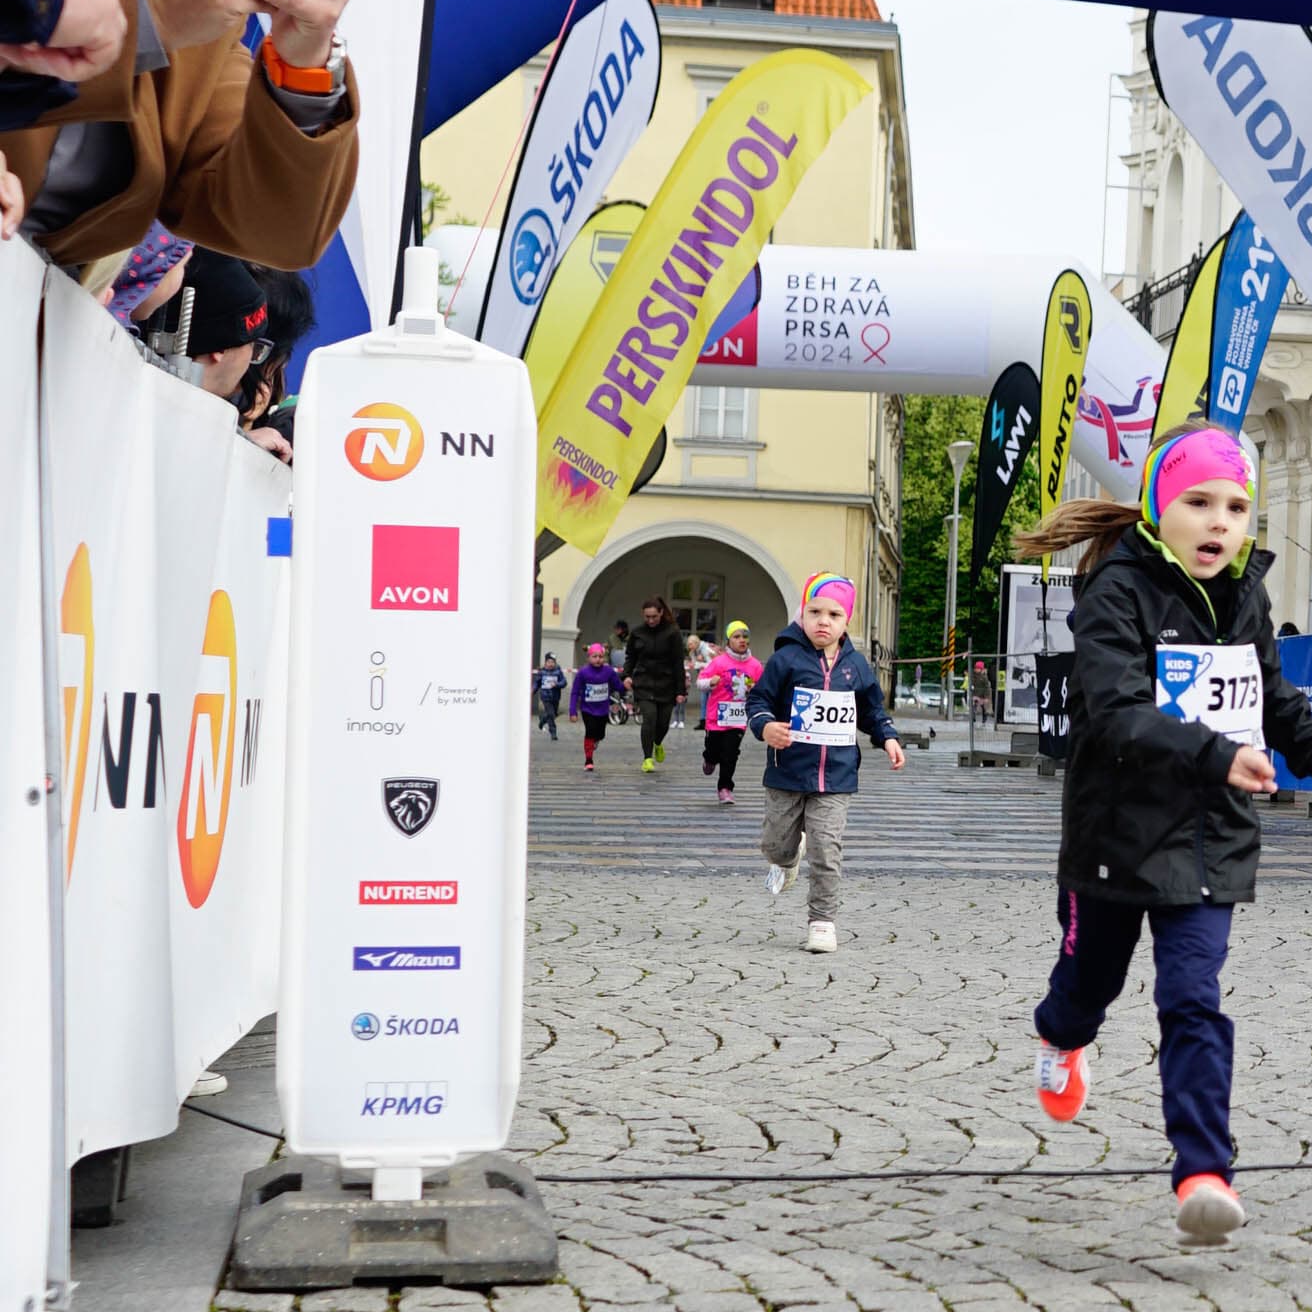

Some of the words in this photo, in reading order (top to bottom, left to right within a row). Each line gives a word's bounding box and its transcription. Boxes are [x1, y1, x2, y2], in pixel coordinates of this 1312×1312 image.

[549, 18, 645, 224] ŠKODA
[585, 115, 798, 438] PERSKINDOL
[787, 273, 836, 291] BĚH
[849, 277, 881, 293] ZA
[784, 295, 890, 317] ZDRAVÁ
[785, 320, 850, 339] PRSA
[784, 343, 853, 363] 2024
[441, 432, 495, 457] NN
[1047, 374, 1077, 503] RUNTO
[553, 436, 618, 490] PERSKINDOL
[379, 587, 449, 604] AVON
[1165, 659, 1193, 671] KIDS
[1166, 671, 1191, 682] CUP
[438, 696, 449, 705] by
[1208, 674, 1258, 711] 3173
[814, 706, 855, 724] 3022
[346, 718, 405, 736] innogy
[364, 886, 454, 900] NUTREND
[384, 1016, 460, 1036] ŠKODA
[361, 1096, 443, 1116] KPMG
